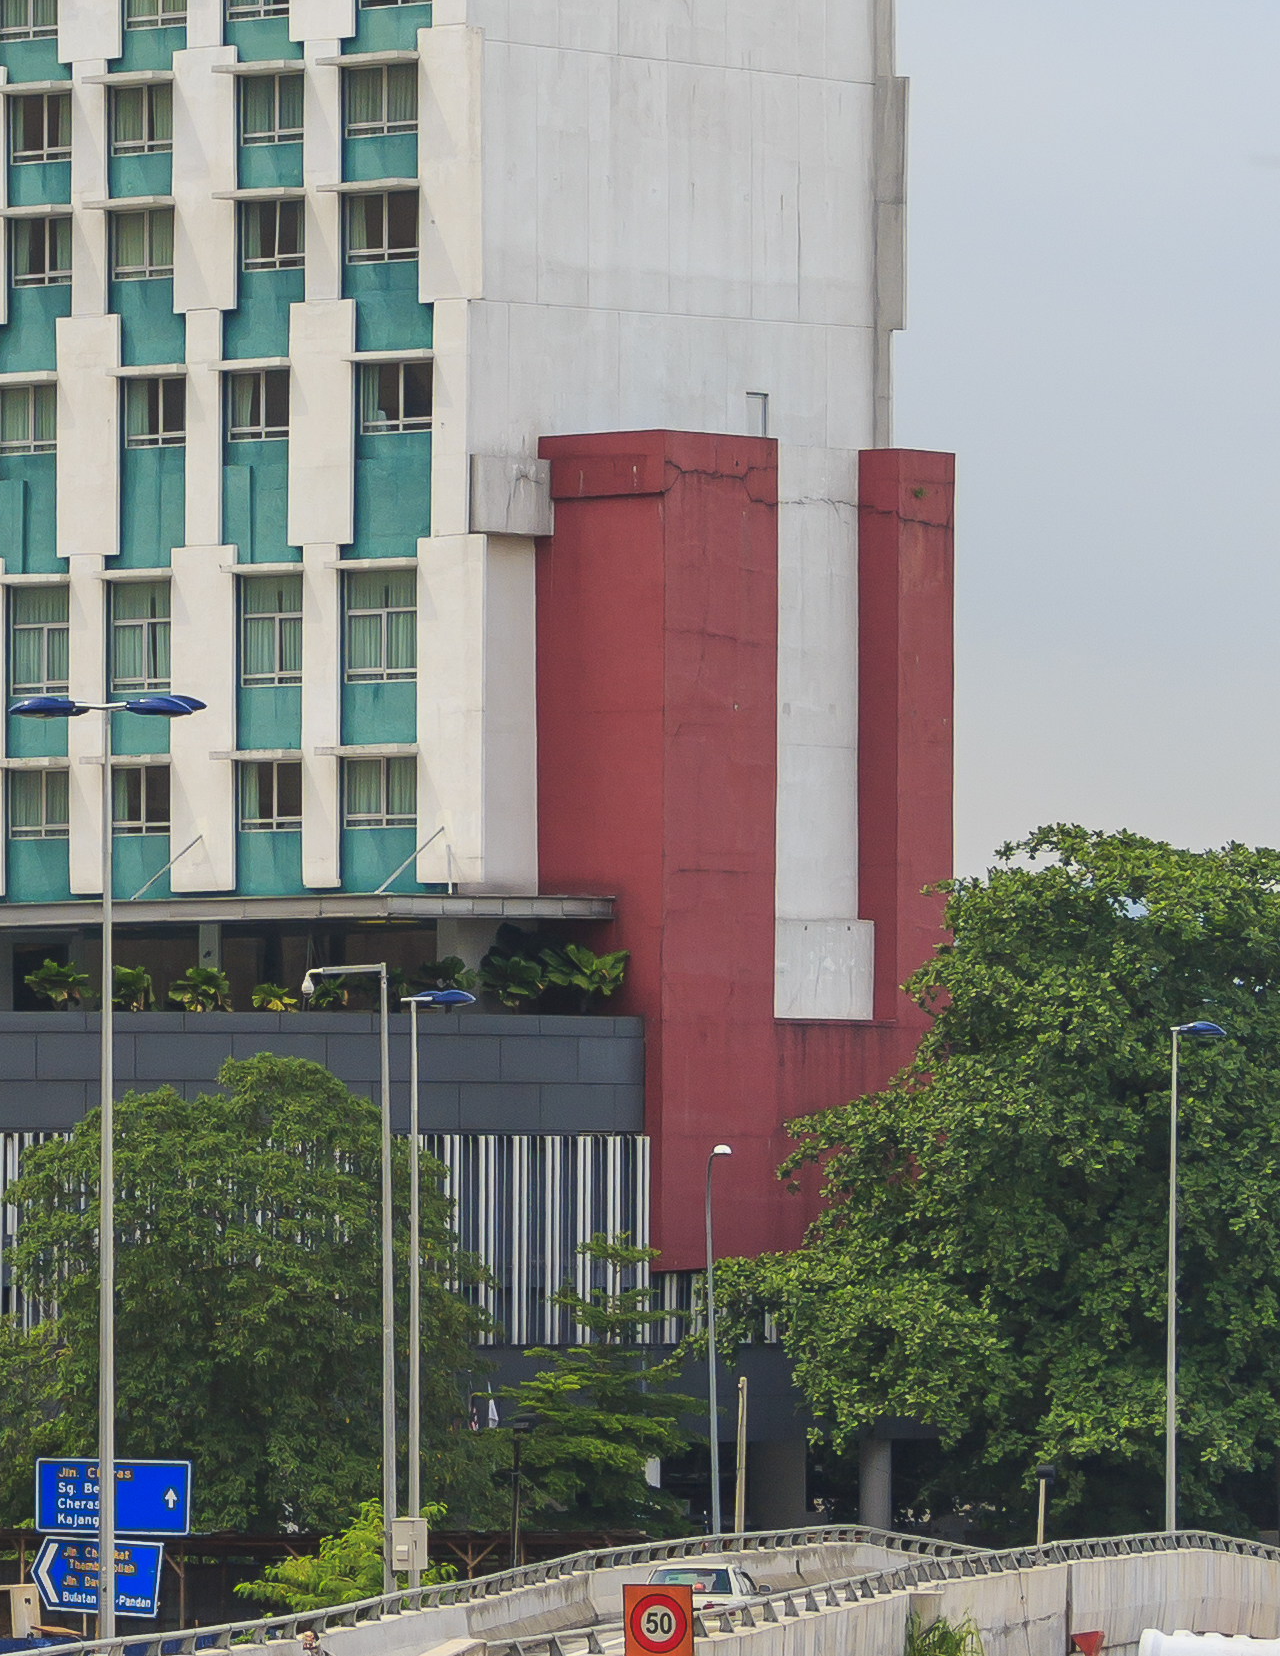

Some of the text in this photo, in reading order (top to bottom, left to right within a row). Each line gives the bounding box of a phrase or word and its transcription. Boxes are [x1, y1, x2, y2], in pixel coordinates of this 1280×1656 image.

[58, 1467, 80, 1478] Jln.
[58, 1482, 77, 1496] Sg.
[57, 1498, 100, 1510] Cheras
[57, 1513, 100, 1528] Kajang
[62, 1591, 97, 1604] Bulatan
[645, 1612, 673, 1635] 50
